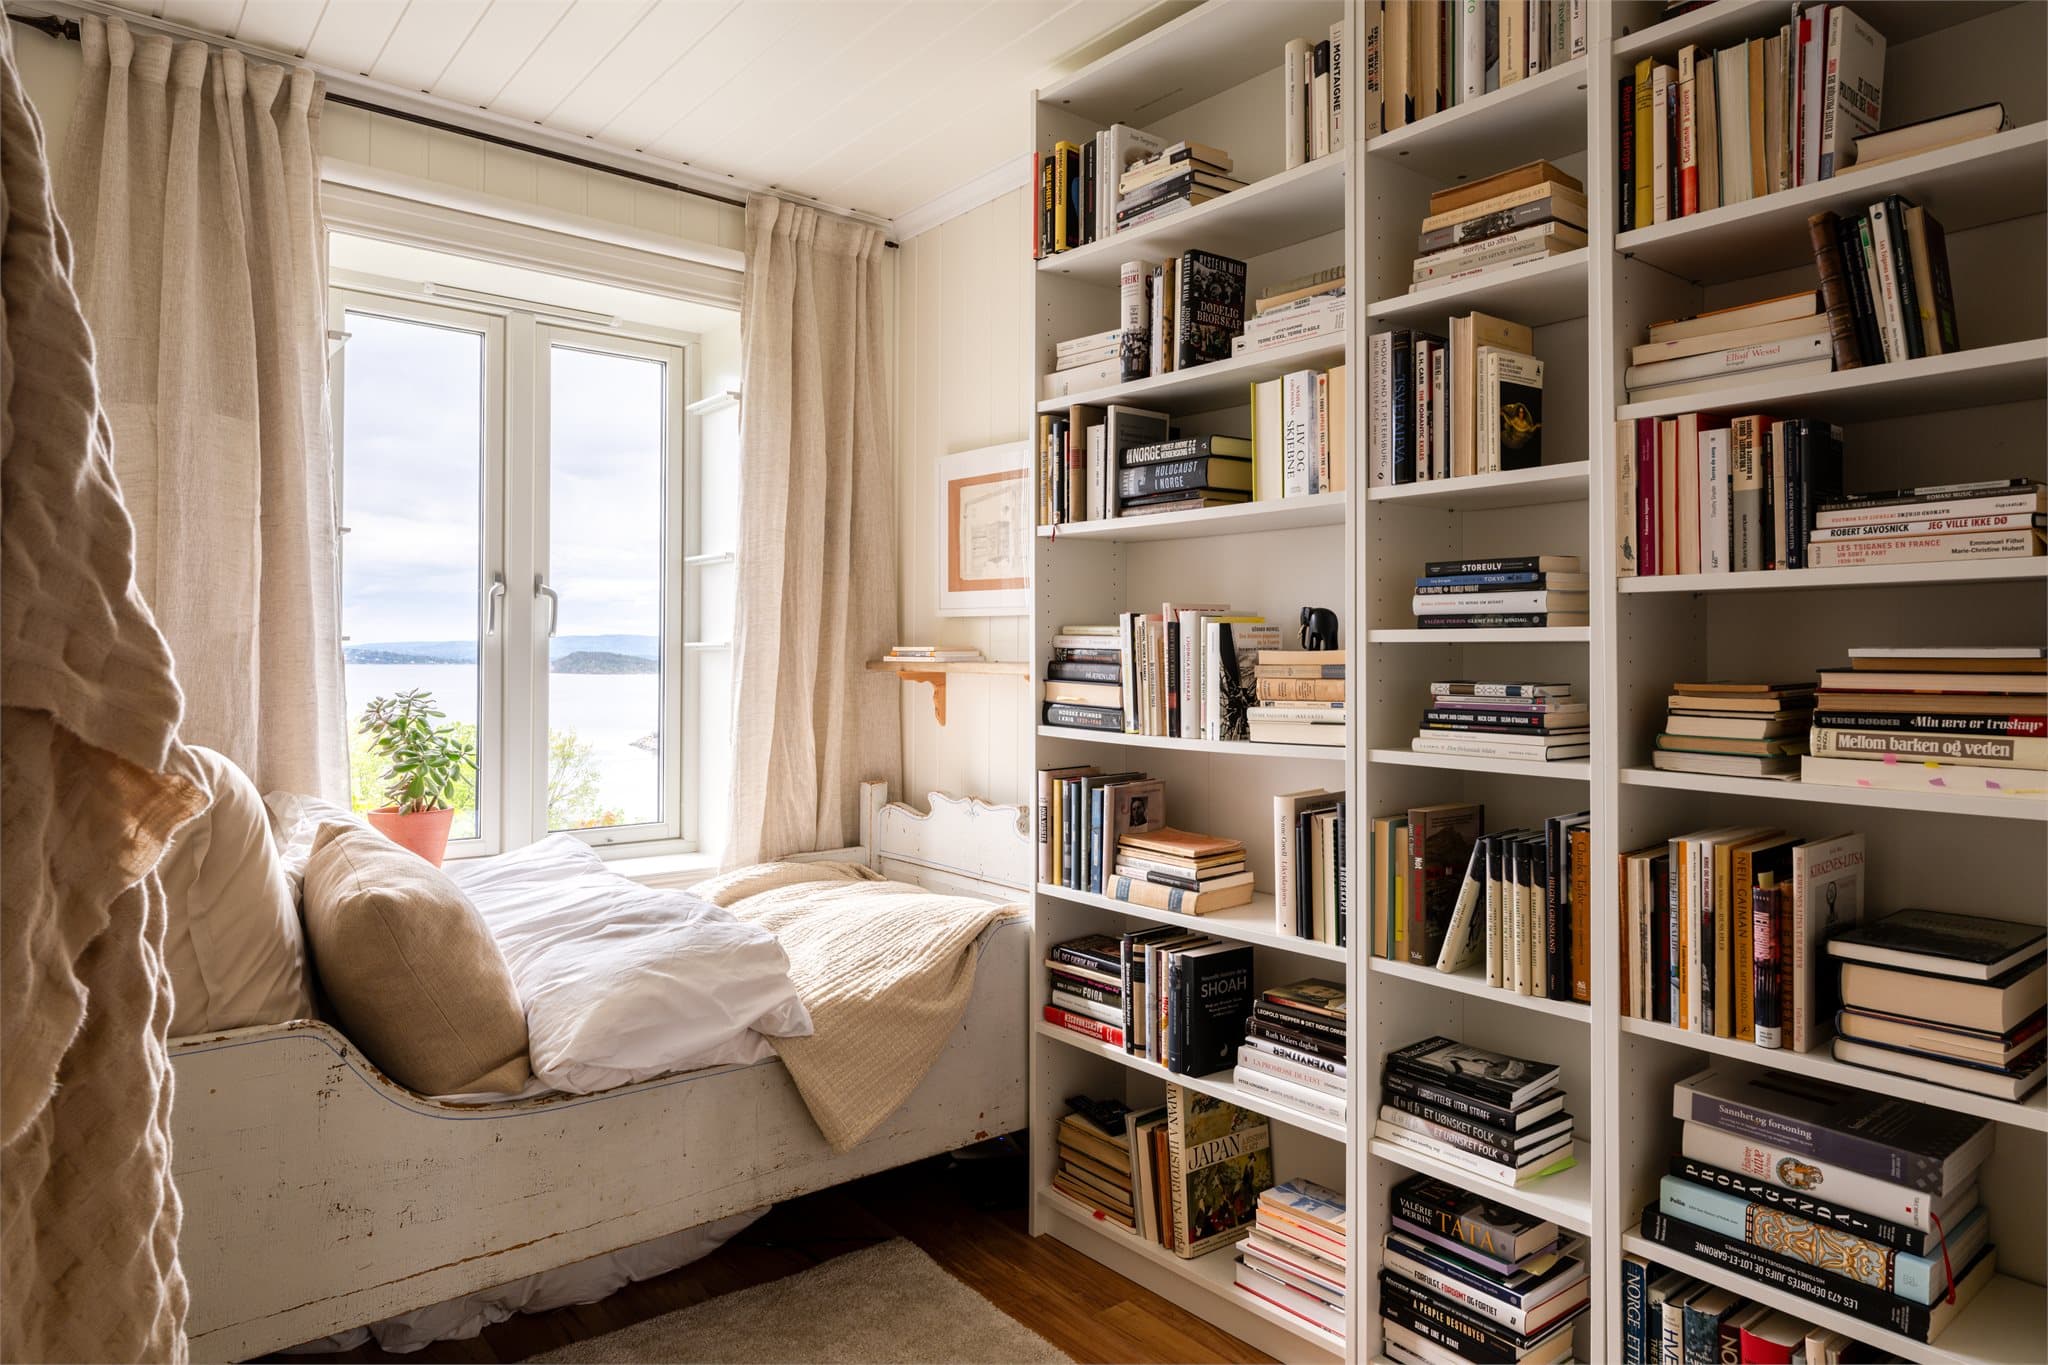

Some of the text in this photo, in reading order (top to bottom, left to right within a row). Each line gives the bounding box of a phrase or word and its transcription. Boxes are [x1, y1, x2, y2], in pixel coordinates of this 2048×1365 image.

[1333, 44, 1341, 112] MONTAIGNE
[1197, 310, 1242, 329] BRORSKAP
[1752, 345, 1780, 358] Wessel
[1132, 445, 1161, 463] NORGE
[1285, 420, 1295, 479] SKJEBNE
[1296, 423, 1305, 472] LIV OG
[1155, 461, 1199, 477] HOLOCAUST
[1160, 476, 1184, 489] NORGE
[1830, 516, 2008, 537] ROBERT SAVOSNICK JEG VILLE IKKE DØ
[1837, 544, 1852, 552] LES
[1854, 543, 1892, 551] TSIGANES
[1909, 539, 1941, 547] FRANCE
[1952, 546, 2000, 554] Marie-Christine
[1461, 563, 1502, 572] STOREULV
[1821, 716, 1856, 724] SVERRE
[1942, 719, 1966, 728] ære
[1970, 720, 1981, 729] er
[1838, 734, 2010, 757] Mellom barken og veden
[1414, 856, 1423, 870] Not
[1576, 840, 1587, 905] Charles Taylor
[1737, 856, 1748, 1019] NEIL GAIMAN NORSE MYTHOLOGY
[1410, 951, 1423, 960] Yale
[1200, 975, 1247, 998] SHOAH
[1257, 1008, 1330, 1032] LEOPOLD TREPPER DET RØDE
[1265, 1030, 1319, 1053] Ruth Maiers dagbok
[1238, 1077, 1249, 1086] PETER
[1168, 1083, 1178, 1123] JAPAN
[1453, 1100, 1491, 1121] UTEN STRAFF
[1424, 1108, 1494, 1144] ET UØNSKET FOLK
[1719, 1104, 1813, 1141] Sannhet og forsoning
[1188, 1133, 1241, 1170] JAPAN
[1434, 1129, 1498, 1159] ET UØNSKET FOLK
[1169, 1139, 1181, 1196] HISTORY
[1752, 1149, 1765, 1177] juive
[1173, 1199, 1182, 1215] IN
[1400, 1196, 1433, 1217] VALÉRIE
[1685, 1164, 1868, 1229] PROPAGANDA!
[1402, 1207, 1432, 1225] PERRIN
[1436, 1209, 1496, 1255] TATA
[1724, 1243, 1749, 1258] ARCHIVES
[1694, 1241, 1858, 1310] LES 473 DÉPORTÉS JUIFS DE LOT-ET-GARONNE
[1758, 1255, 1797, 1275] INDIVIDUELLES
[1797, 1268, 1826, 1285] HISTOIRES
[1466, 1296, 1475, 1306] OG
[1474, 1298, 1497, 1317] FORTIET
[1627, 1272, 1641, 1329] NORGE
[1412, 1299, 1485, 1343] A PEOPLE DESTROYED
[1430, 1328, 1440, 1340] LIKE
[1446, 1337, 1459, 1350] STATE
[1650, 1339, 1658, 1355] THE
[1664, 1328, 1679, 1365] HVE
[1721, 1334, 1738, 1365] NO
